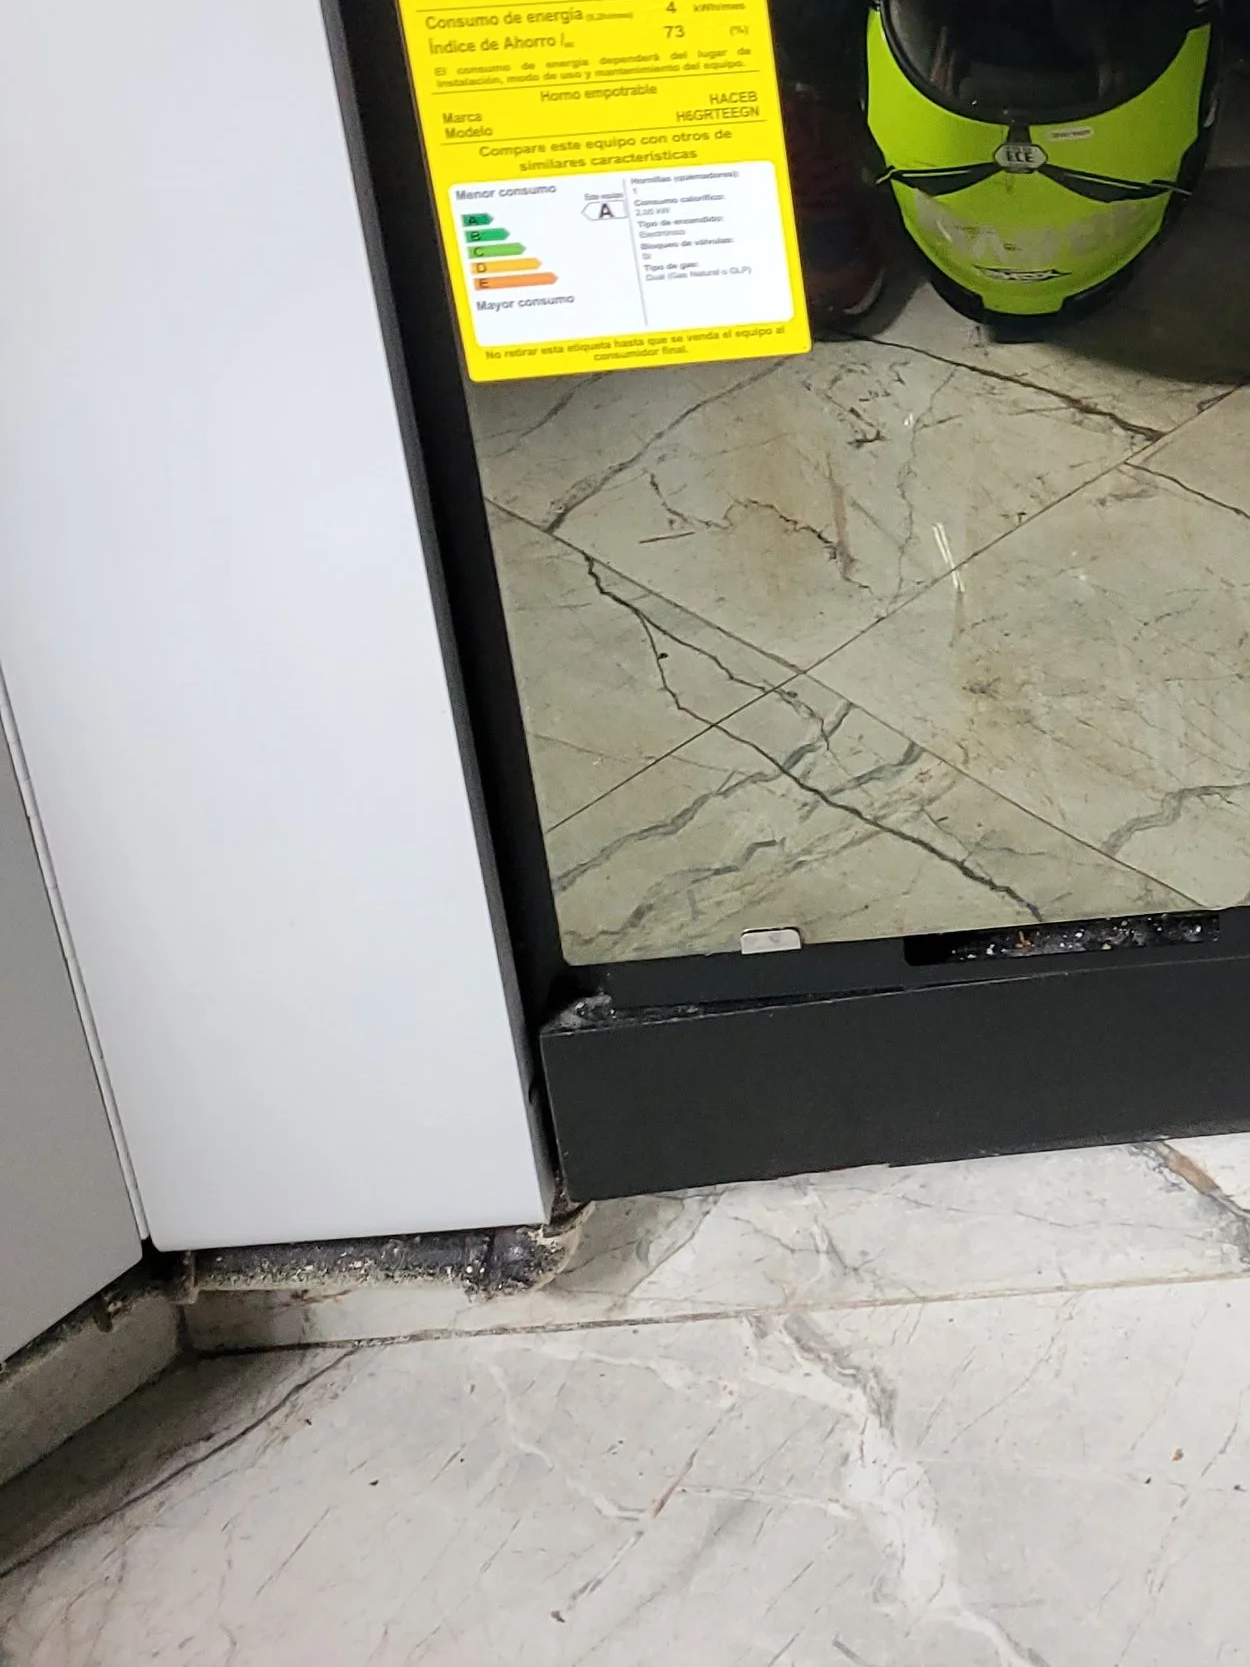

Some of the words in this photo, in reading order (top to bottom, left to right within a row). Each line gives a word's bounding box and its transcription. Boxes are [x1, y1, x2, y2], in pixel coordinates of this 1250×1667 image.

[665, 1, 677, 14] 4
[425, 15, 499, 30] Consumo
[503, 11, 522, 25] de
[527, 7, 583, 24] energía
[663, 25, 685, 39] 73
[428, 37, 476, 55] Índice
[480, 38, 499, 52] de
[503, 35, 557, 50] Ahorro
[434, 67, 447, 77] El
[456, 64, 511, 75] consumo
[521, 62, 535, 71] de
[670, 51, 687, 61] del
[697, 49, 727, 60] lugar
[737, 47, 751, 56] de
[506, 74, 540, 84] modo
[543, 72, 557, 81] de
[560, 71, 581, 80] uso
[584, 71, 591, 81] y
[595, 65, 680, 78] mantenimiento
[683, 62, 700, 72] del
[584, 83, 658, 100] empotrable
[709, 91, 758, 106] HACEB
[442, 112, 483, 124] Marca
[445, 125, 493, 140] Modelo
[479, 143, 547, 157] Compare
[550, 141, 581, 152] este
[586, 135, 636, 150] equipo
[640, 133, 668, 145] con
[672, 130, 710, 143] otros
[714, 128, 732, 140] de
[519, 157, 587, 172] similares
[590, 148, 698, 167] características
[455, 188, 496, 201] Menor
[498, 185, 557, 198] consumo
[599, 203, 614, 219] A
[470, 230, 481, 242] B
[473, 246, 484, 257] C
[476, 262, 487, 273] D
[480, 278, 489, 288] E
[476, 300, 515, 312] Mayor
[517, 295, 575, 308] consumo
[485, 350, 502, 360] No
[504, 347, 537, 358] retirar
[541, 345, 564, 355] esta
[567, 338, 611, 353] etiqueta
[614, 338, 644, 349] hasta
[647, 336, 667, 347] que
[671, 335, 683, 344] se
[687, 331, 719, 342] venda
[722, 329, 732, 339] el
[735, 327, 772, 339] equipo
[775, 325, 785, 335] al
[593, 346, 660, 362] consumidor
